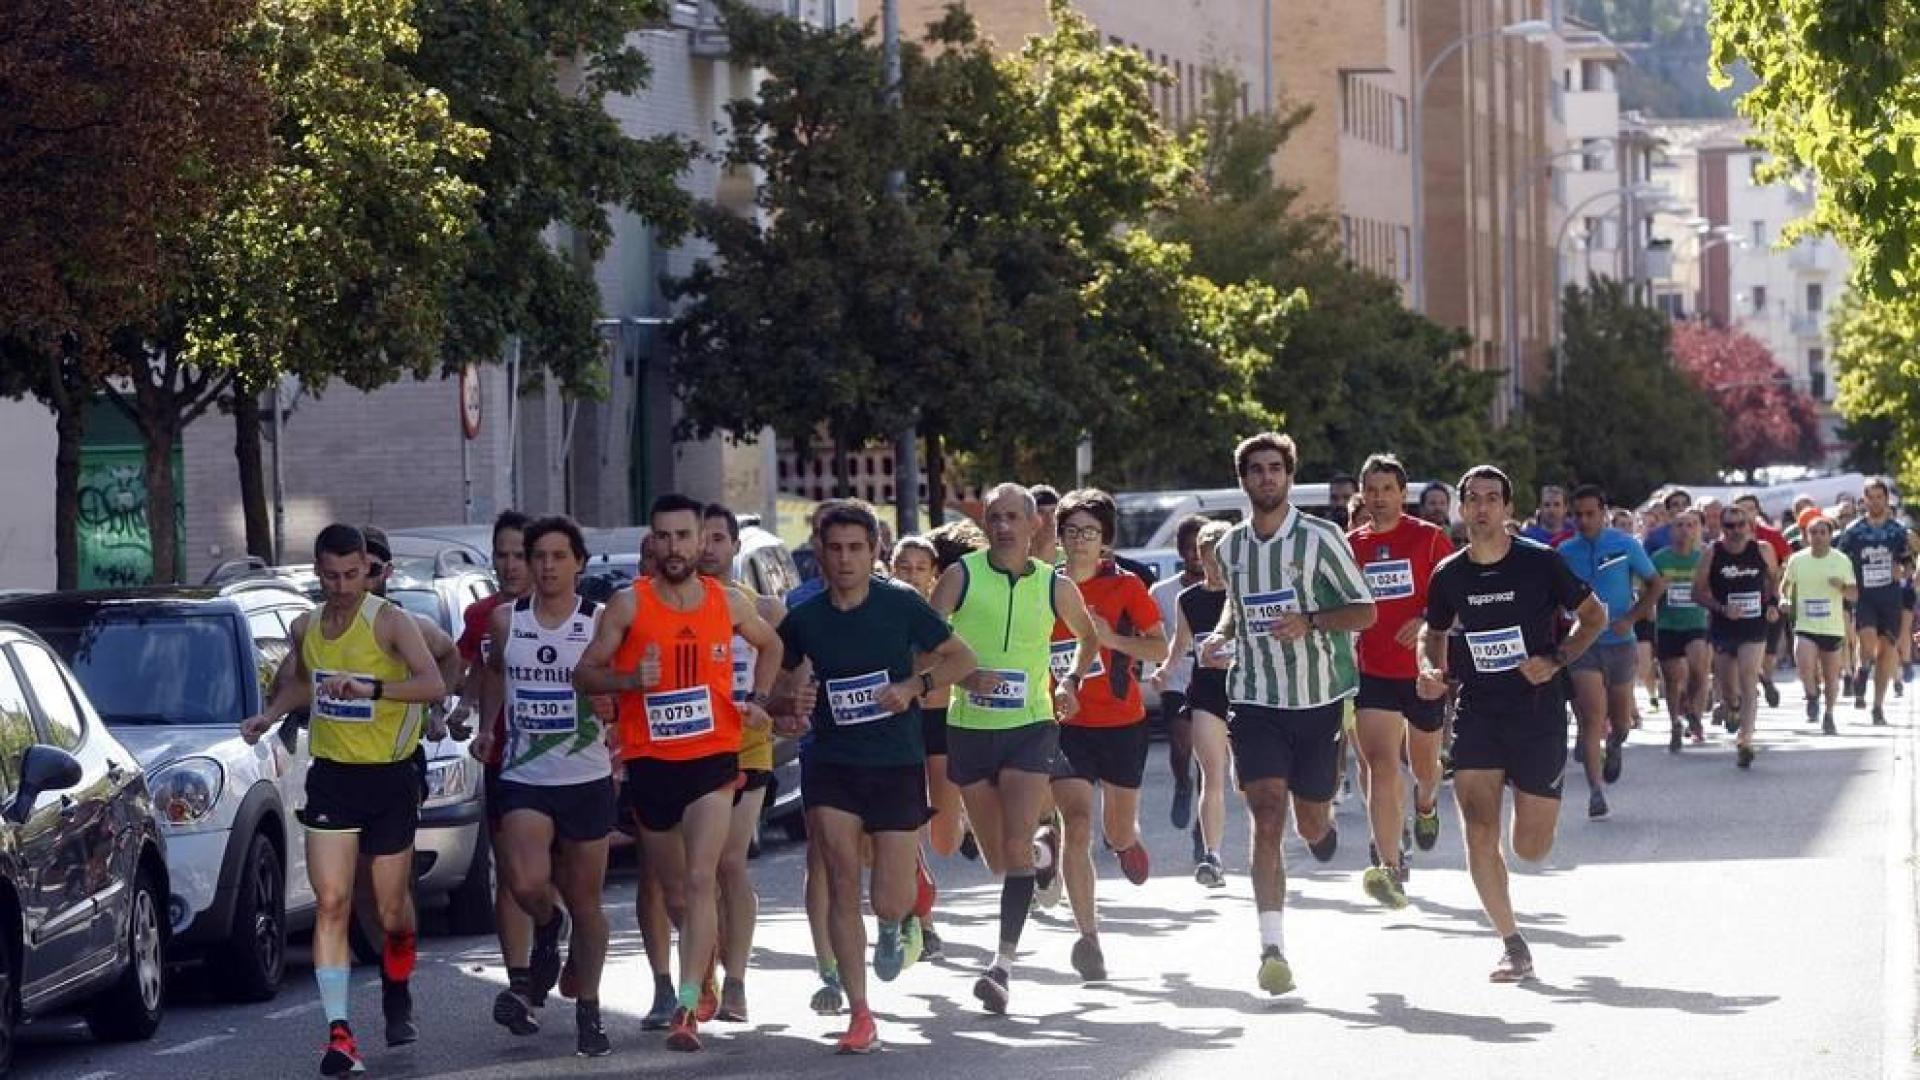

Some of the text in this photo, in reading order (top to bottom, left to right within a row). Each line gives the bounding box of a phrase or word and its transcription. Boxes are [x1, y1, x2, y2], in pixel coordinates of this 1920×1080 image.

[1260, 604, 1282, 618] 108
[847, 689, 872, 705] 107
[531, 703, 558, 716] 130
[664, 705, 693, 721] 079
